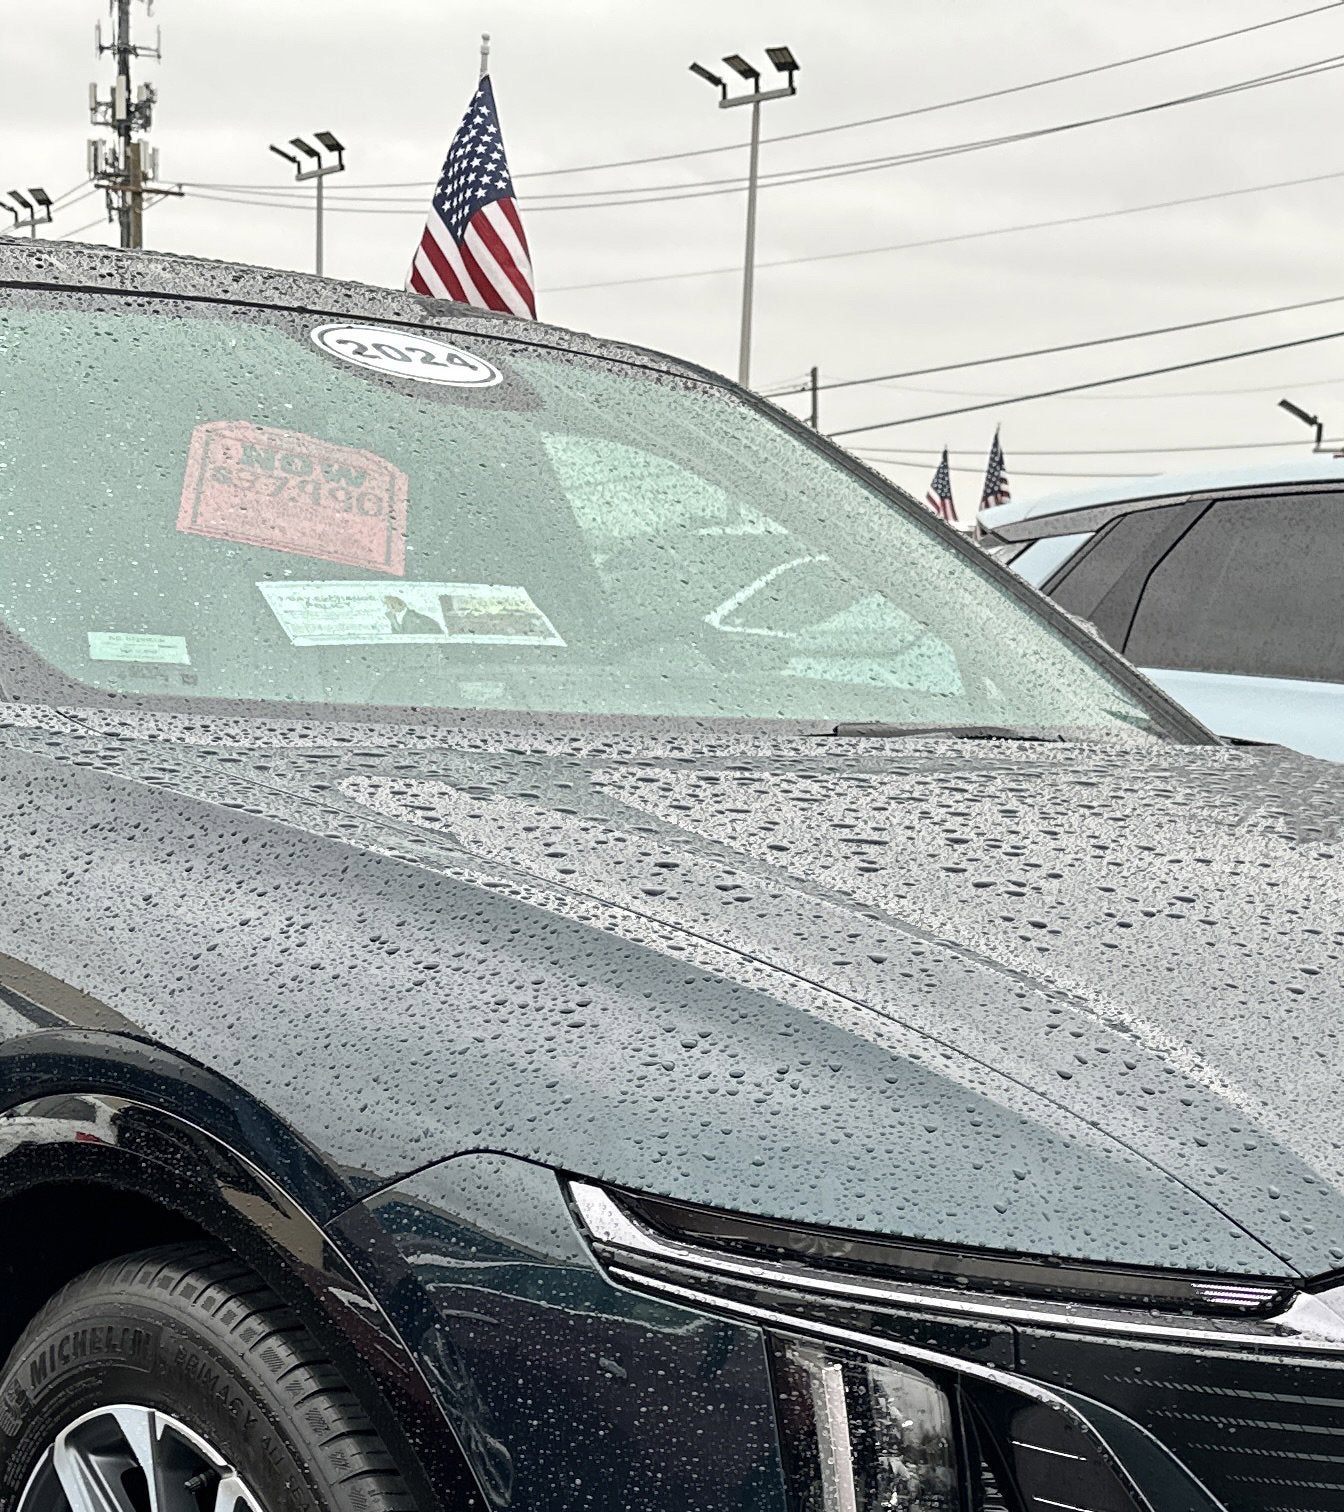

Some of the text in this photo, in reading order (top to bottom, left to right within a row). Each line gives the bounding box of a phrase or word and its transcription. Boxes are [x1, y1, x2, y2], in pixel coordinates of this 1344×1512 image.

[335, 338, 479, 371] 2024
[240, 442, 369, 488] NOW
[30, 1325, 153, 1388] MICHELIN
[173, 1346, 258, 1431] PRIMACY
